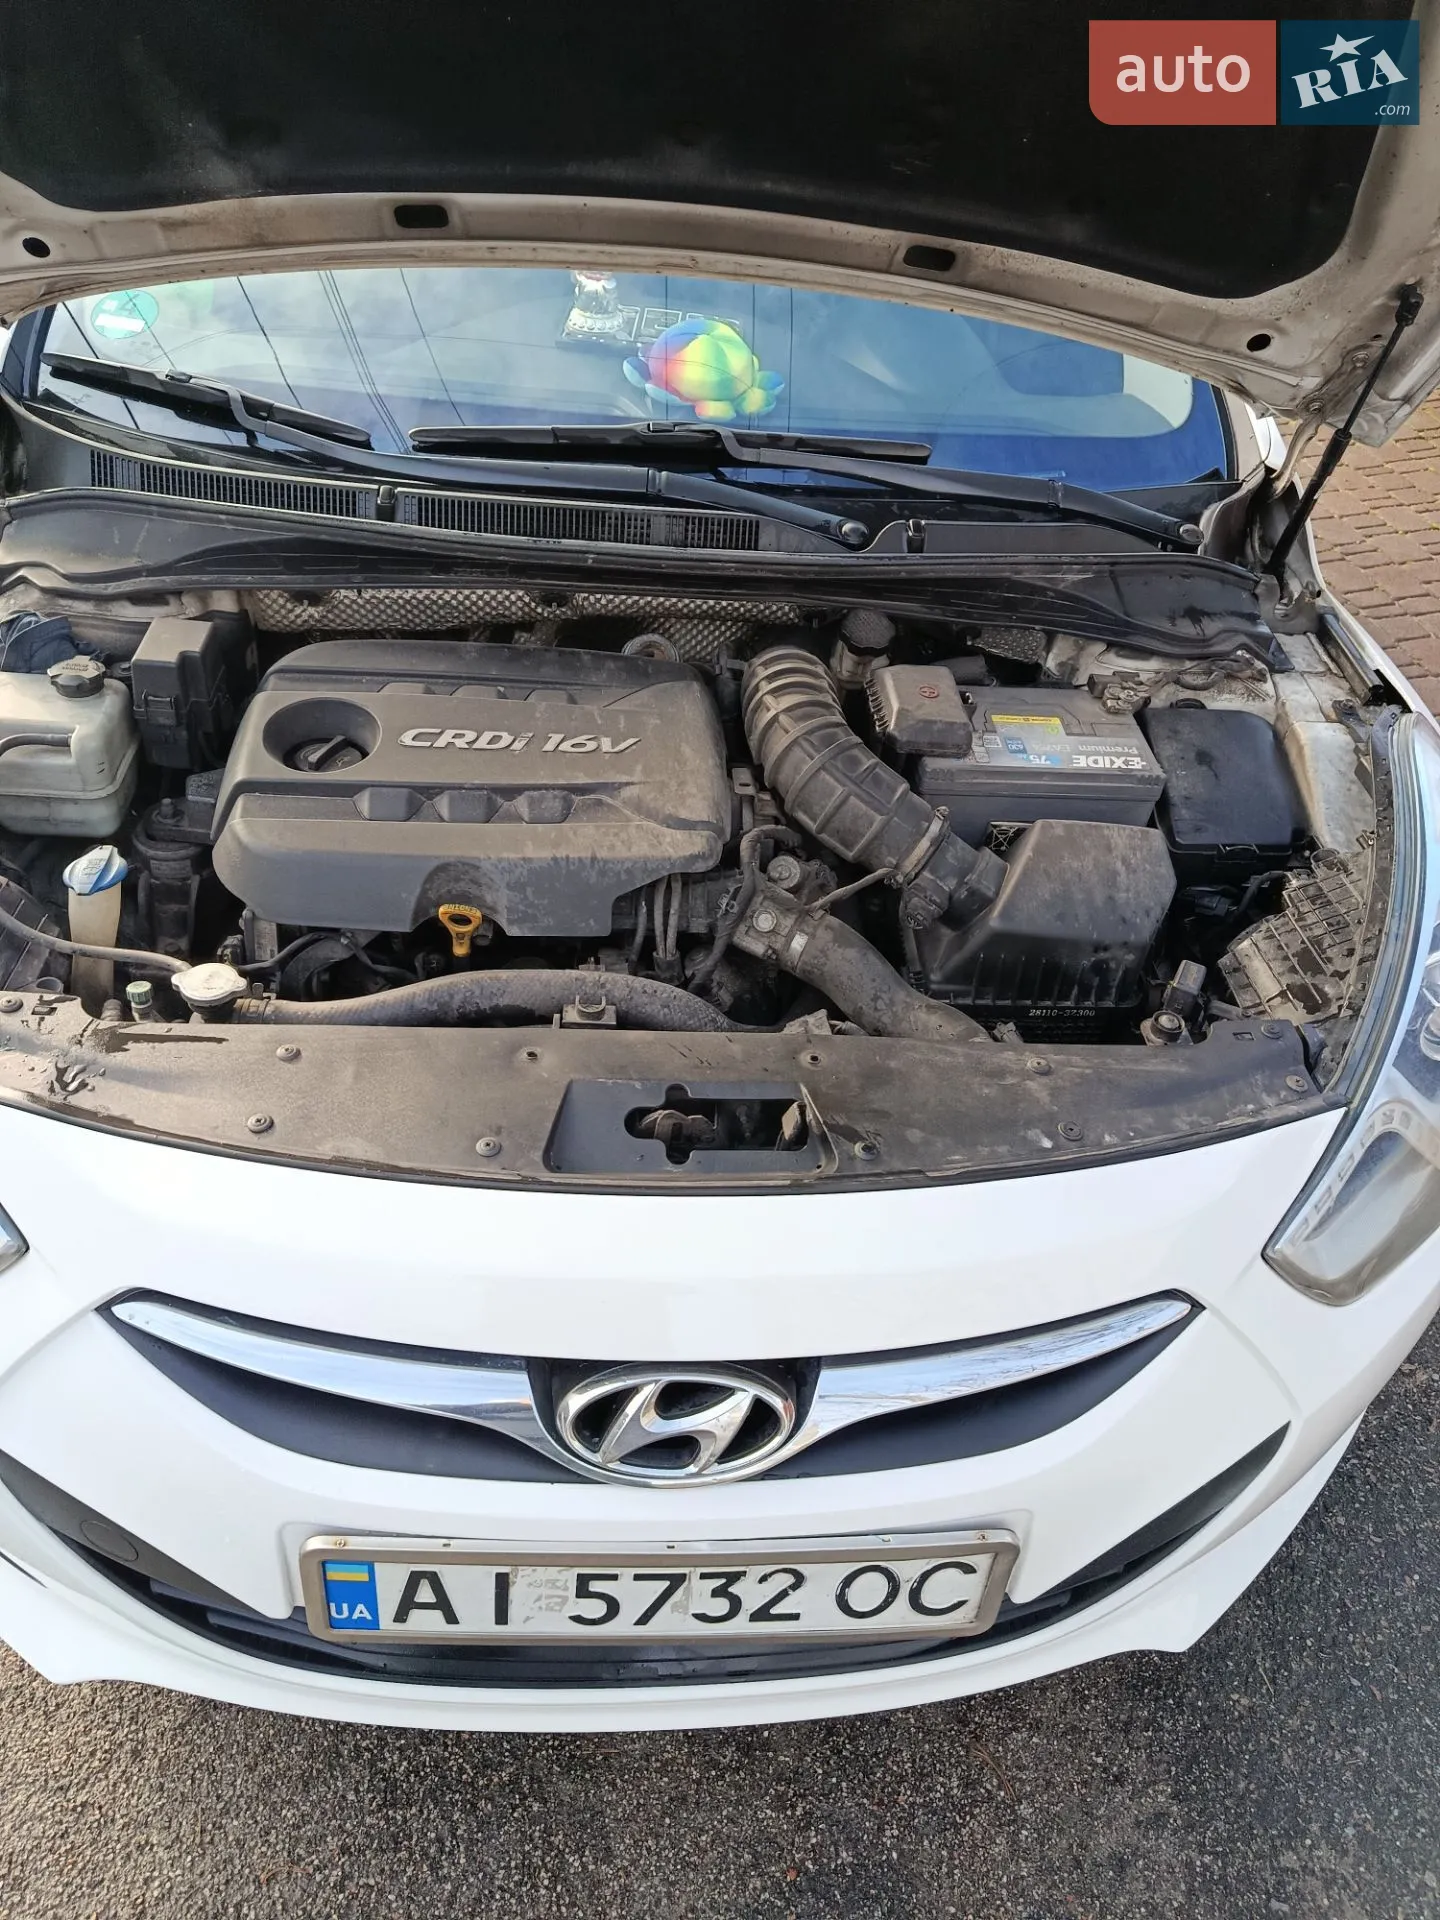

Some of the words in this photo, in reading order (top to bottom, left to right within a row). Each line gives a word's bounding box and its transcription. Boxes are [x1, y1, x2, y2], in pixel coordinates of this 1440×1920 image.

[398, 728, 534, 751] CRDi
[542, 733, 641, 753] 16V
[1079, 744, 1138, 756] Premium
[1030, 754, 1051, 764] 75
[1072, 755, 1146, 769] EXIDE
[392, 1570, 508, 1626] AI
[568, 1568, 804, 1624] 5732
[834, 1560, 978, 1618] OC
[330, 1600, 373, 1621] UA
